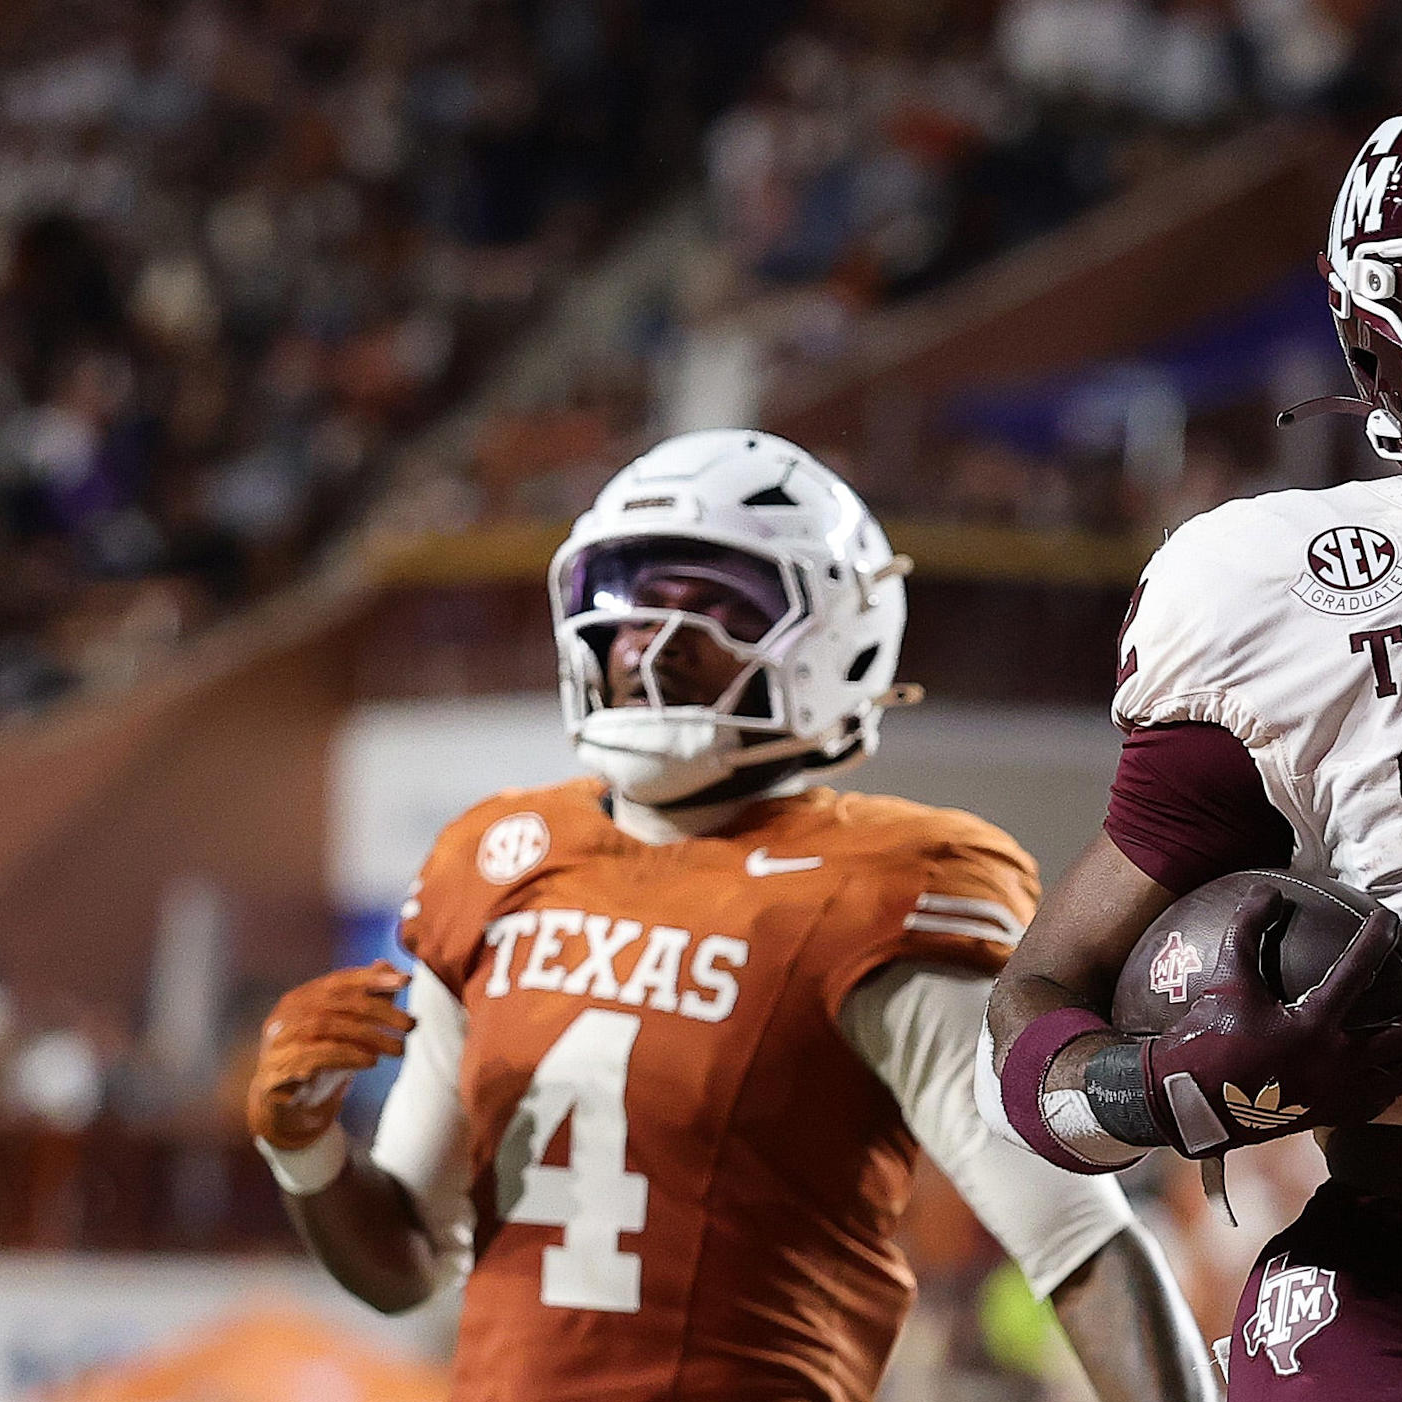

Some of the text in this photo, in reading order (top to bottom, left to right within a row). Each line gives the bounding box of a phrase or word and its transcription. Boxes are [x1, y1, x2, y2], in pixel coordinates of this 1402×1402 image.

[1311, 528, 1391, 587] SEC
[485, 909, 749, 1024] TEXAS
[496, 1011, 648, 1313] 4
